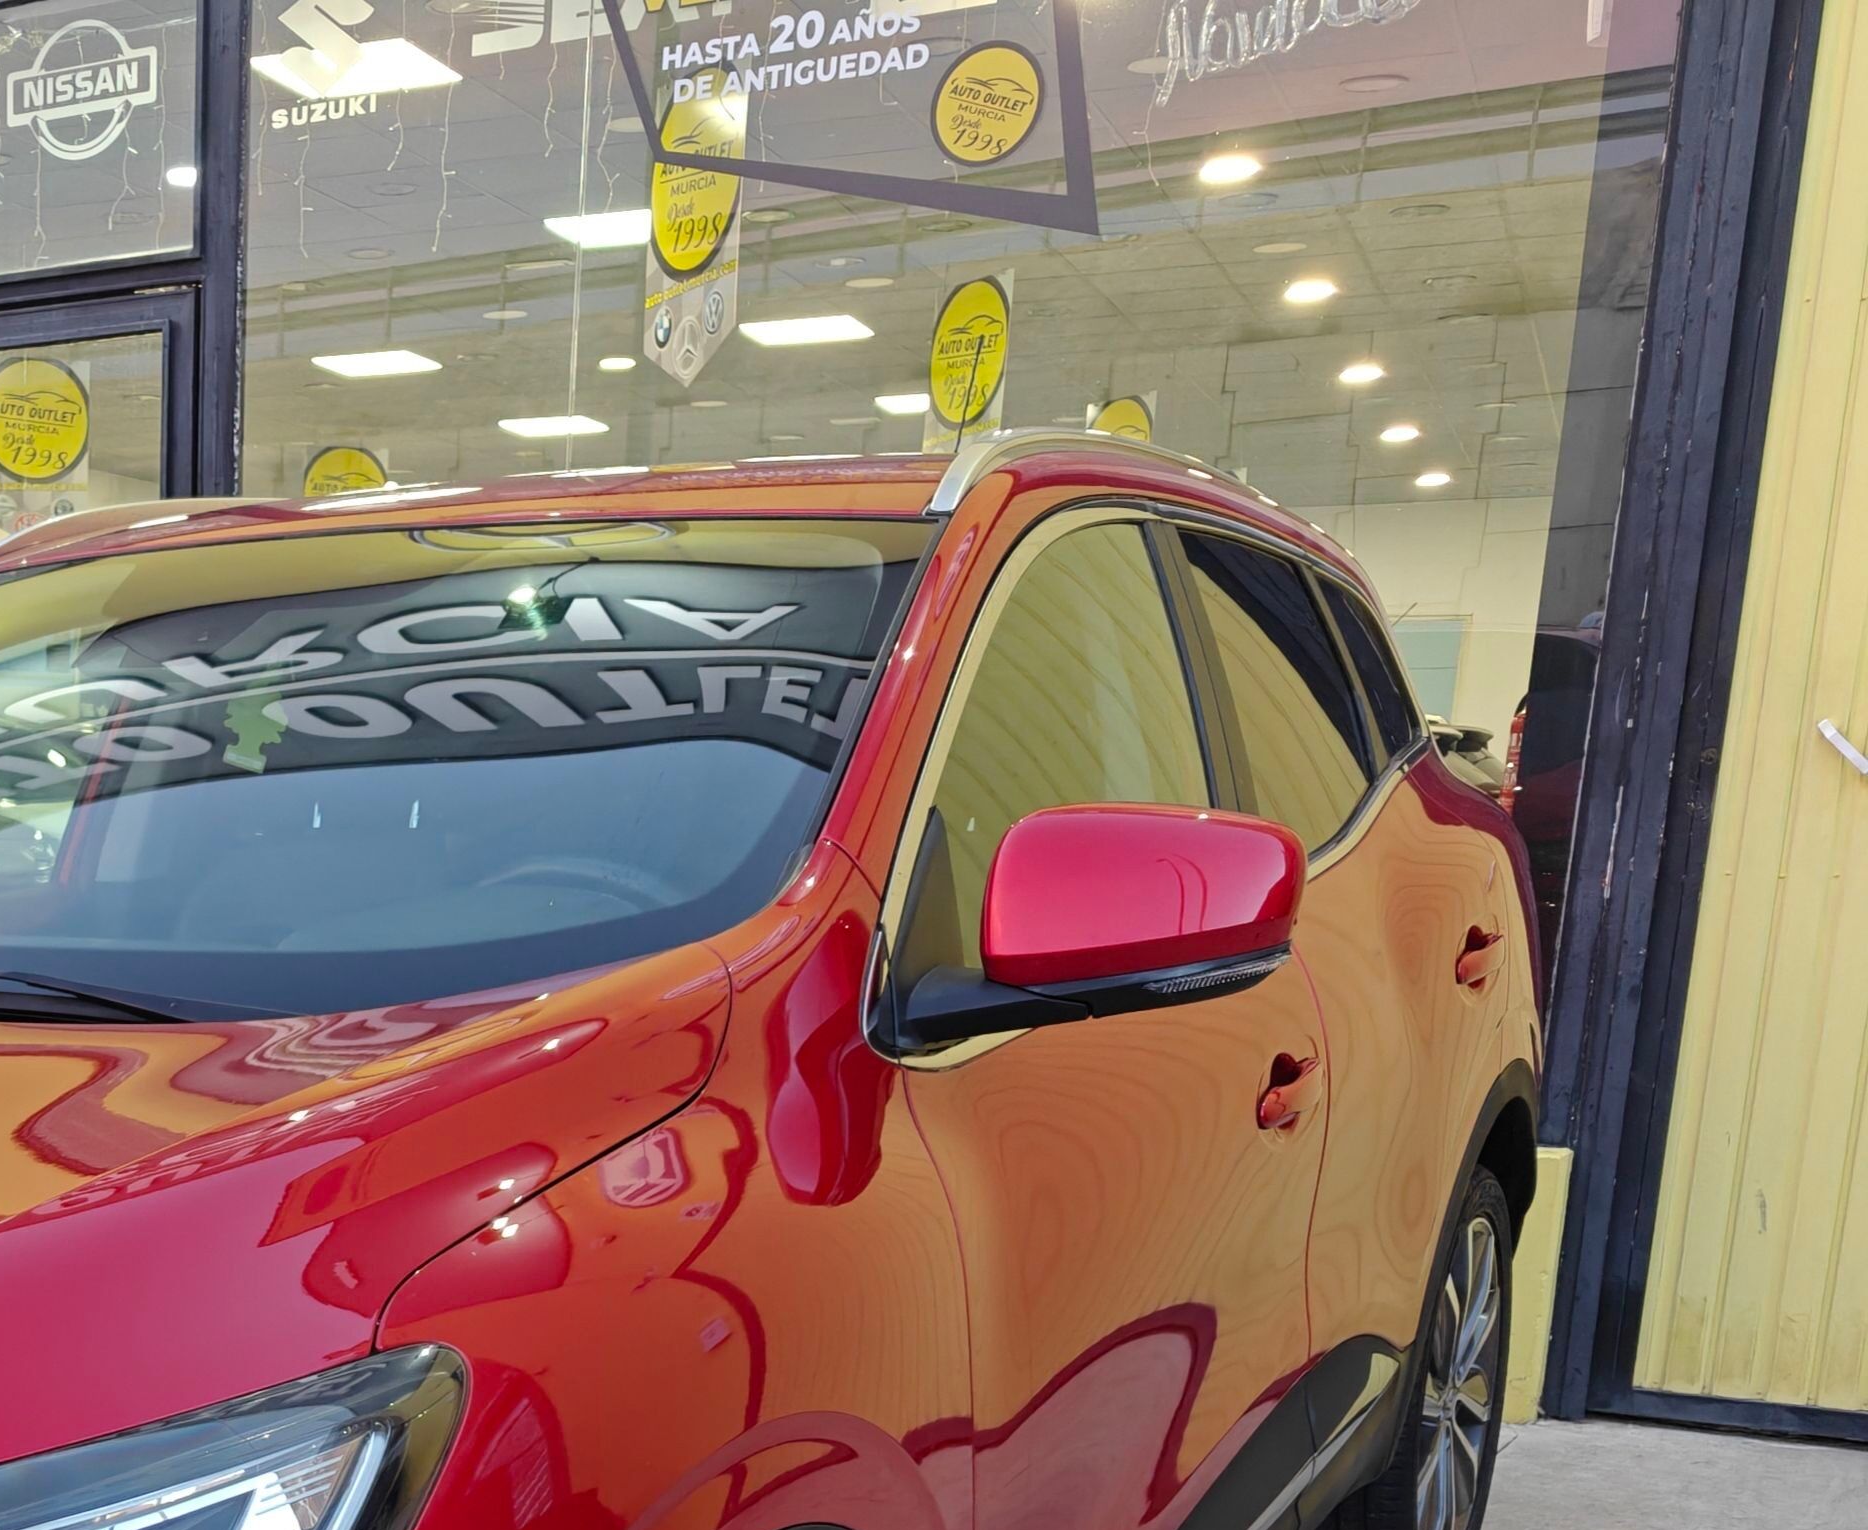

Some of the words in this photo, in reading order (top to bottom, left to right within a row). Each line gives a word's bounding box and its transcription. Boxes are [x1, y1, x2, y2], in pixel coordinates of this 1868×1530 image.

[661, 33, 760, 71] HASTA
[768, 10, 826, 54] 20
[828, 8, 922, 45] AÑOS
[23, 61, 139, 109] NISSAN
[673, 75, 714, 104] DE
[720, 43, 930, 98] ANTIGUEDAD
[949, 84, 981, 101] AUTO
[983, 92, 1028, 113] OUTLET
[271, 94, 377, 129] SUZUKI
[957, 103, 1006, 122] MURCIA
[953, 128, 1007, 155] 1998
[660, 163, 686, 178] AU
[670, 174, 717, 197] MURCIA
[672, 211, 723, 253] 1998
[938, 339, 962, 355] AUTO
[964, 334, 999, 352] OUET
[946, 356, 985, 370] MURA
[29, 407, 76, 424] OUTLET
[4, 421, 59, 435] MURCIA
[11, 447, 69, 469] 1998
